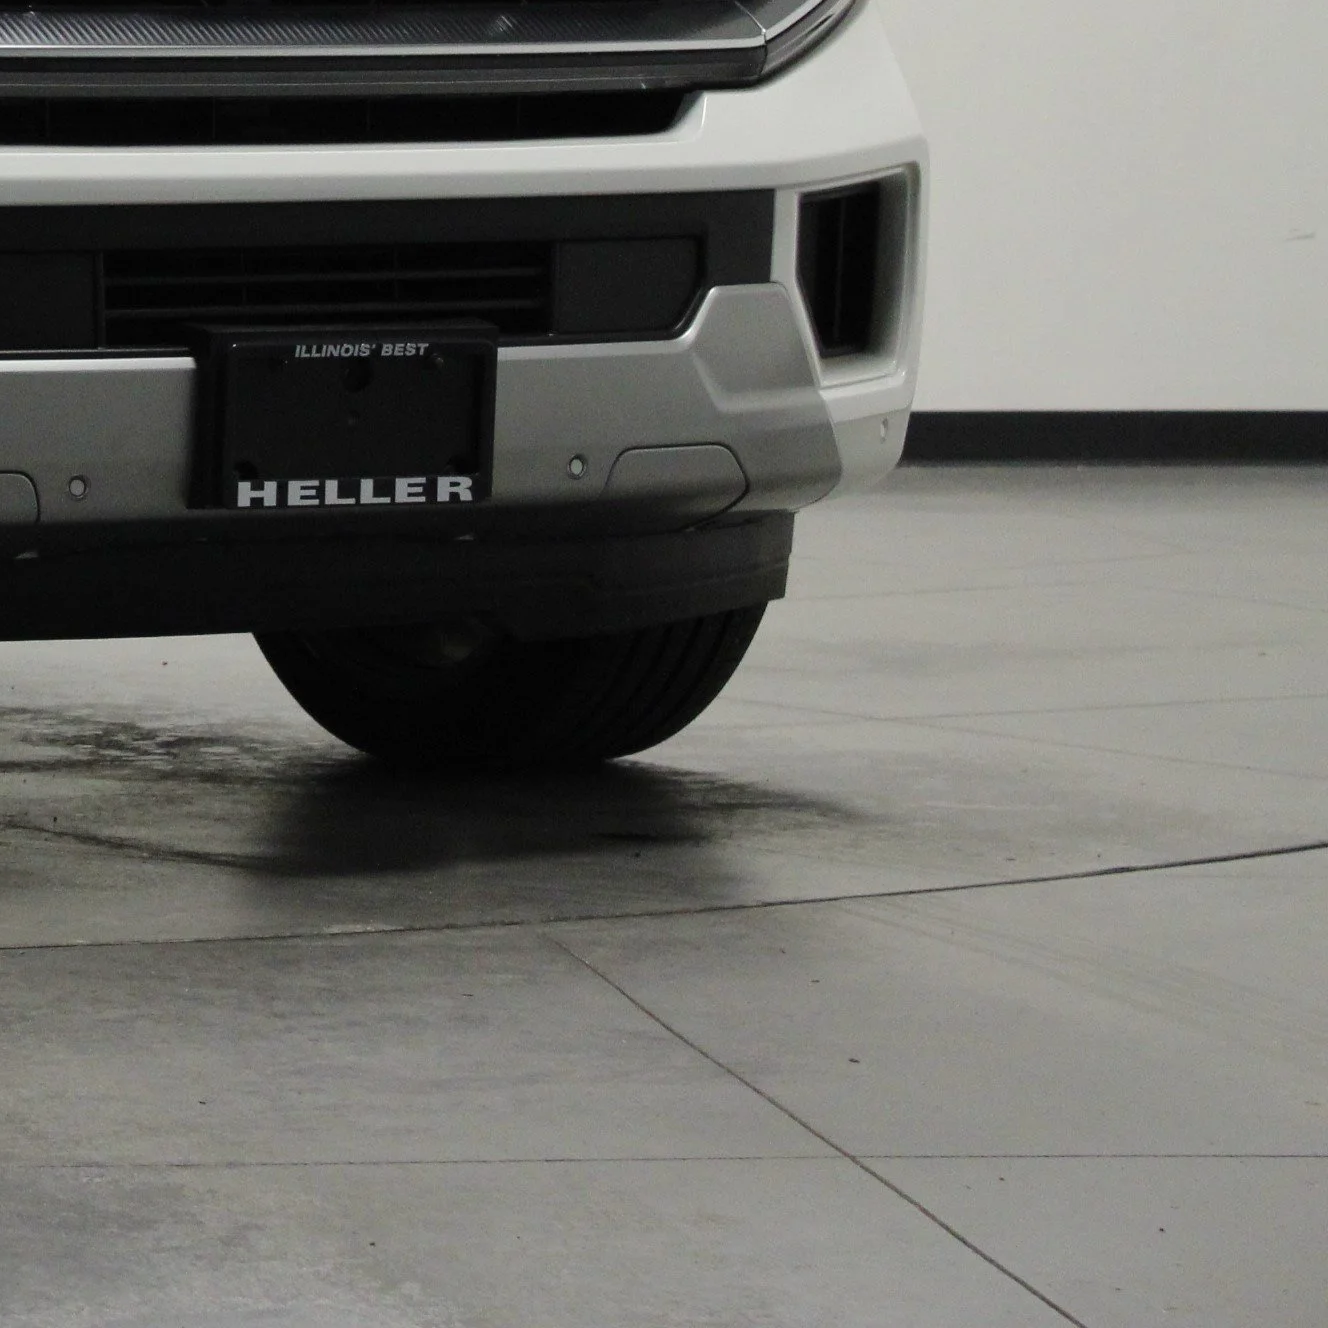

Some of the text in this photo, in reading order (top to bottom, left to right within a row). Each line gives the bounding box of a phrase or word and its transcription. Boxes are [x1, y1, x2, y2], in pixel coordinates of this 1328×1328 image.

[295, 343, 430, 358] ILLINOIS' BEST
[237, 476, 474, 508] HELLER
